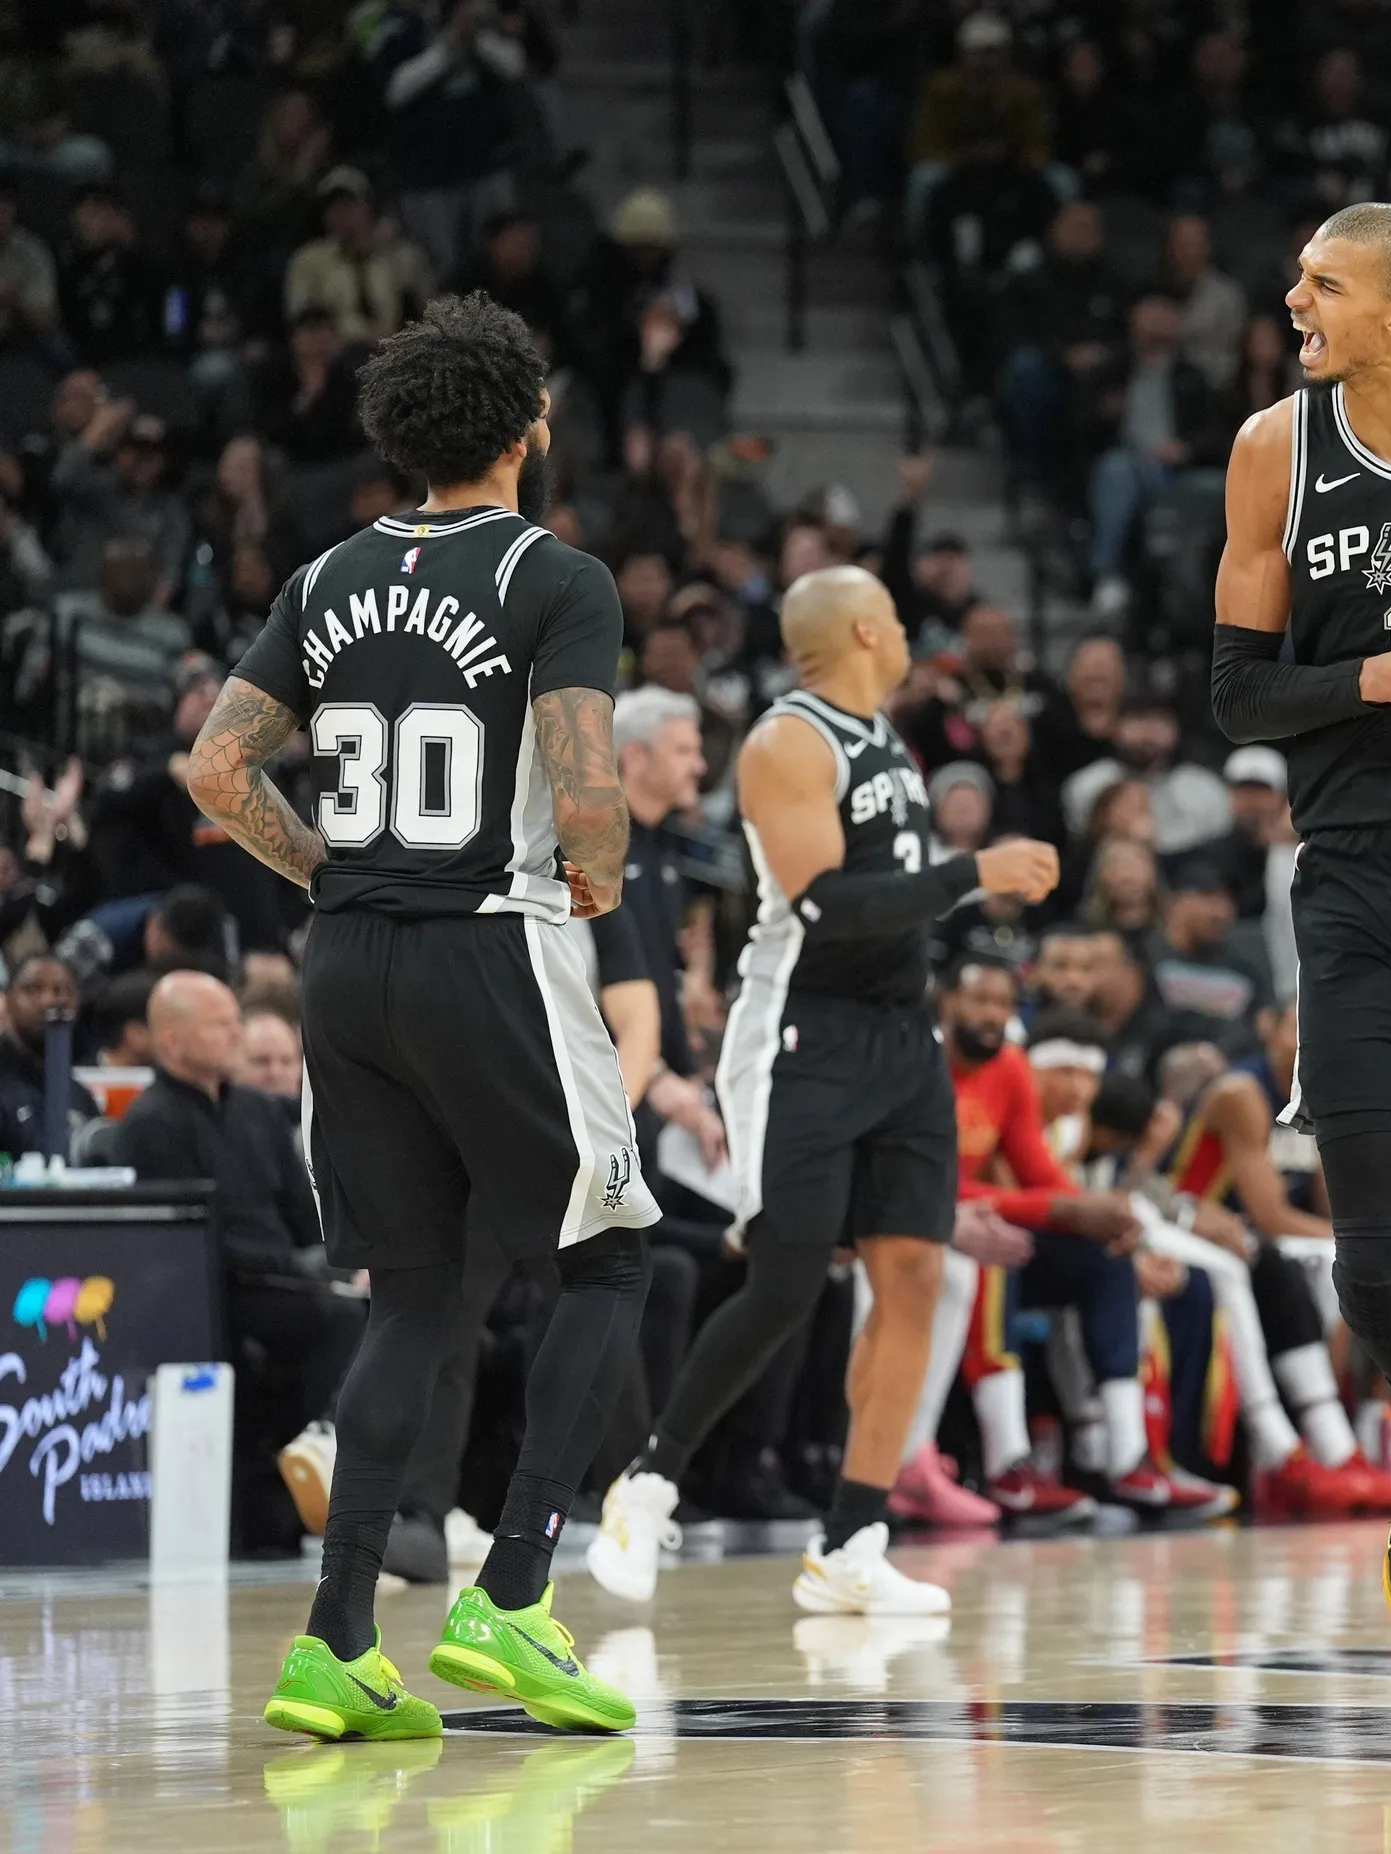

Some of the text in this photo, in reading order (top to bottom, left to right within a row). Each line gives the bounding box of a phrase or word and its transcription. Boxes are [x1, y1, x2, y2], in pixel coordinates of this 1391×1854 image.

[301, 584, 513, 689] CHAMPAGNIE
[309, 701, 486, 850] 30
[0, 1336, 108, 1473] South
[80, 1471, 154, 1501] ISLAN
